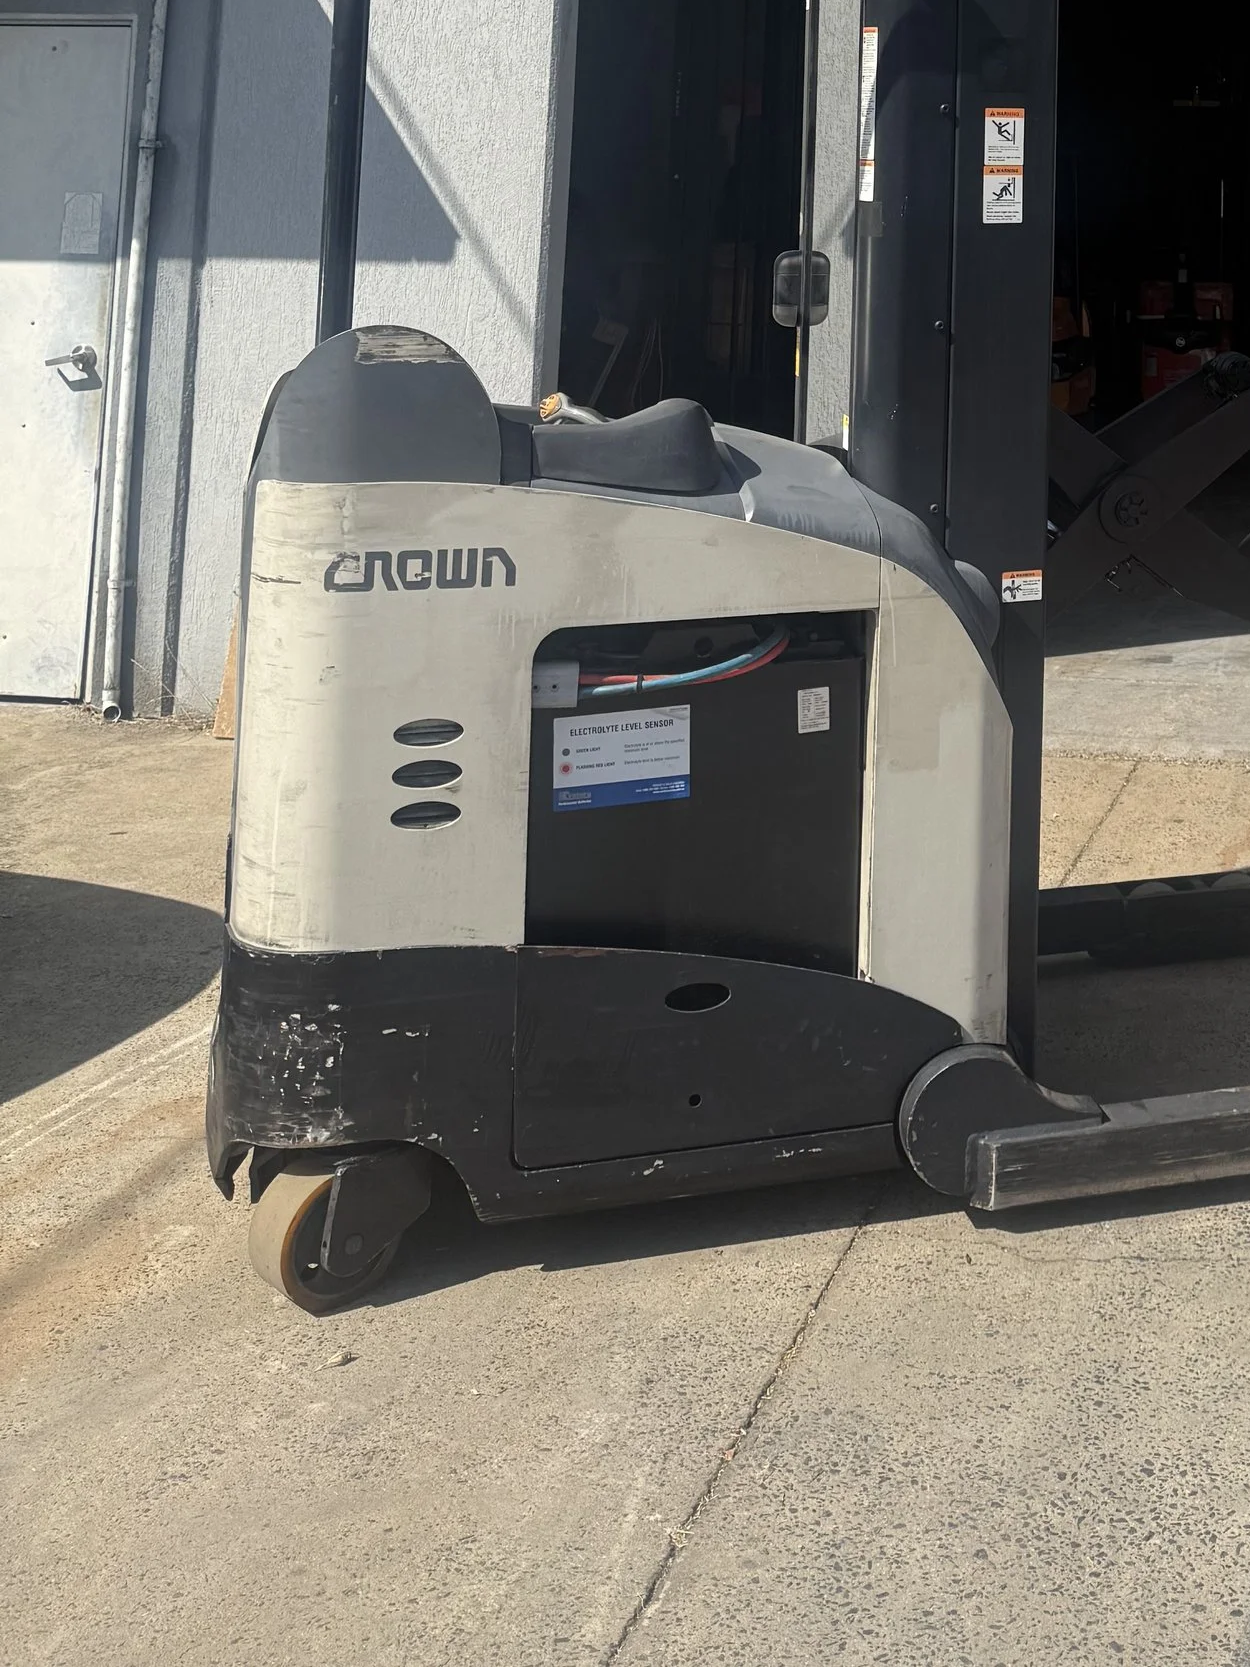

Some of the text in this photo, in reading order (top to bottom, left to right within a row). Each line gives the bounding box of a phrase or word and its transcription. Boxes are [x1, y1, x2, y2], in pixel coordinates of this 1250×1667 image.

[323, 547, 517, 593] CROWN
[570, 719, 674, 736] ELECTROLYTE LEVEL SENSOR
